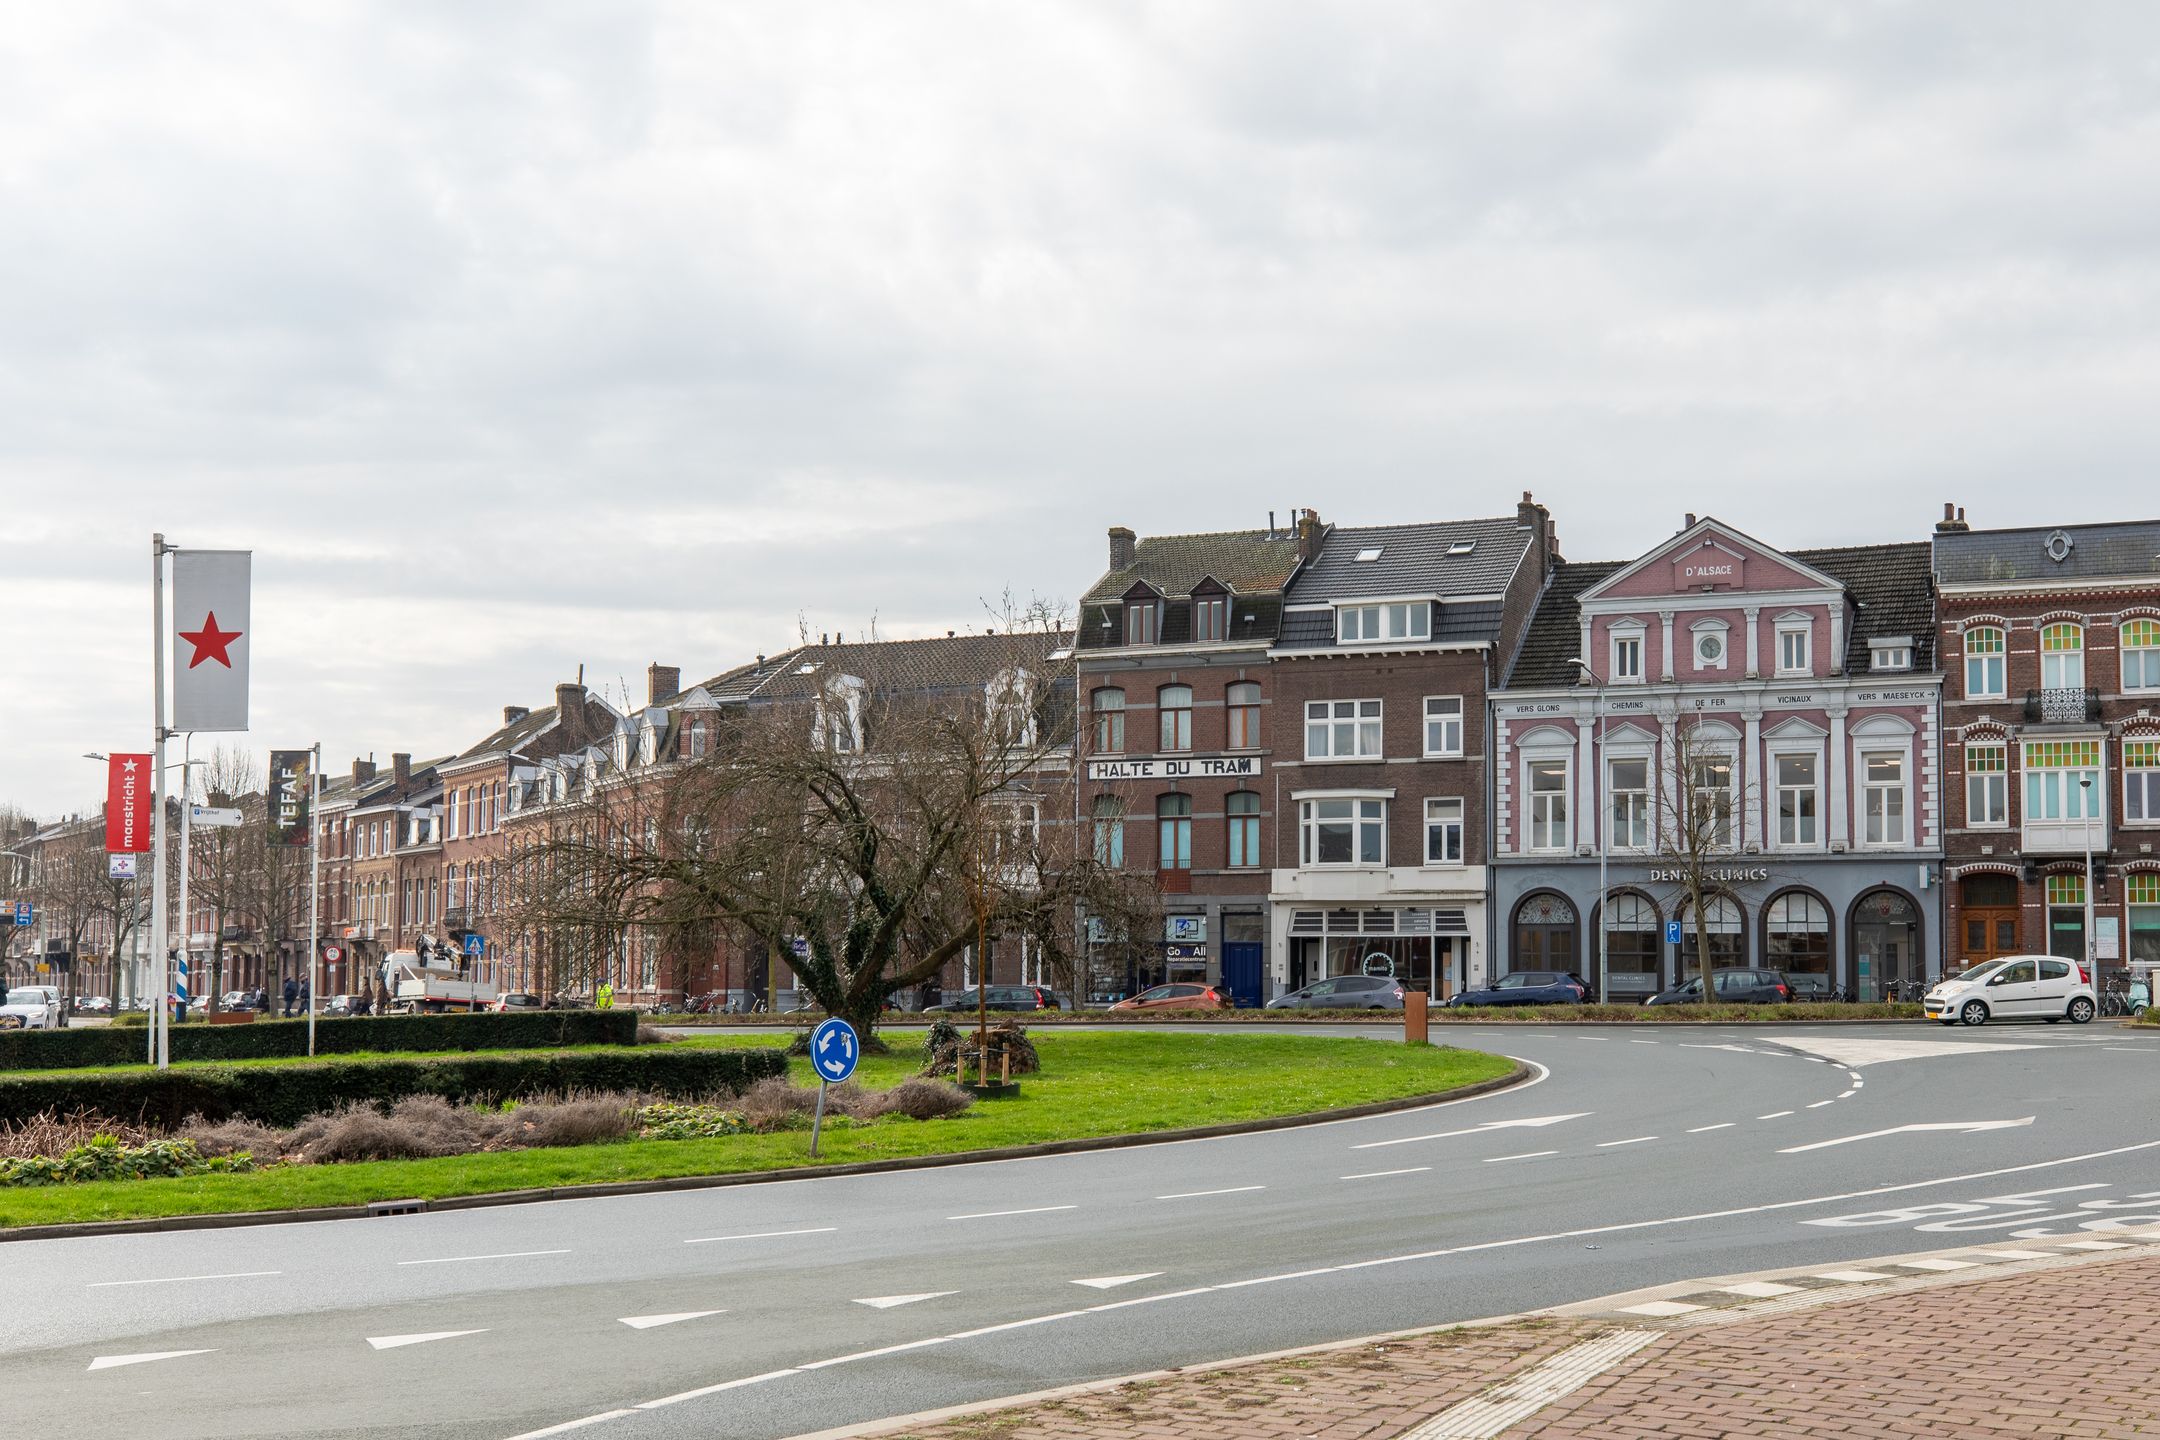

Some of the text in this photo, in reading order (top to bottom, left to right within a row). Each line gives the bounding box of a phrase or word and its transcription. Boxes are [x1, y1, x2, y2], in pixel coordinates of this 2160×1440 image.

[1686, 565, 1732, 577] D'ALSACE
[1611, 695, 1812, 709] CHEMINS DE FER VICINAUX
[1857, 690, 1925, 701] VERS MAESEYCK
[1537, 704, 1560, 712] GLONS
[1097, 758, 1252, 777] HALTE DU TRAM
[280, 767, 297, 830] TEFAF
[123, 775, 136, 848] maastricht
[1710, 868, 1768, 881] CLINICS
[1669, 923, 1677, 934] P
